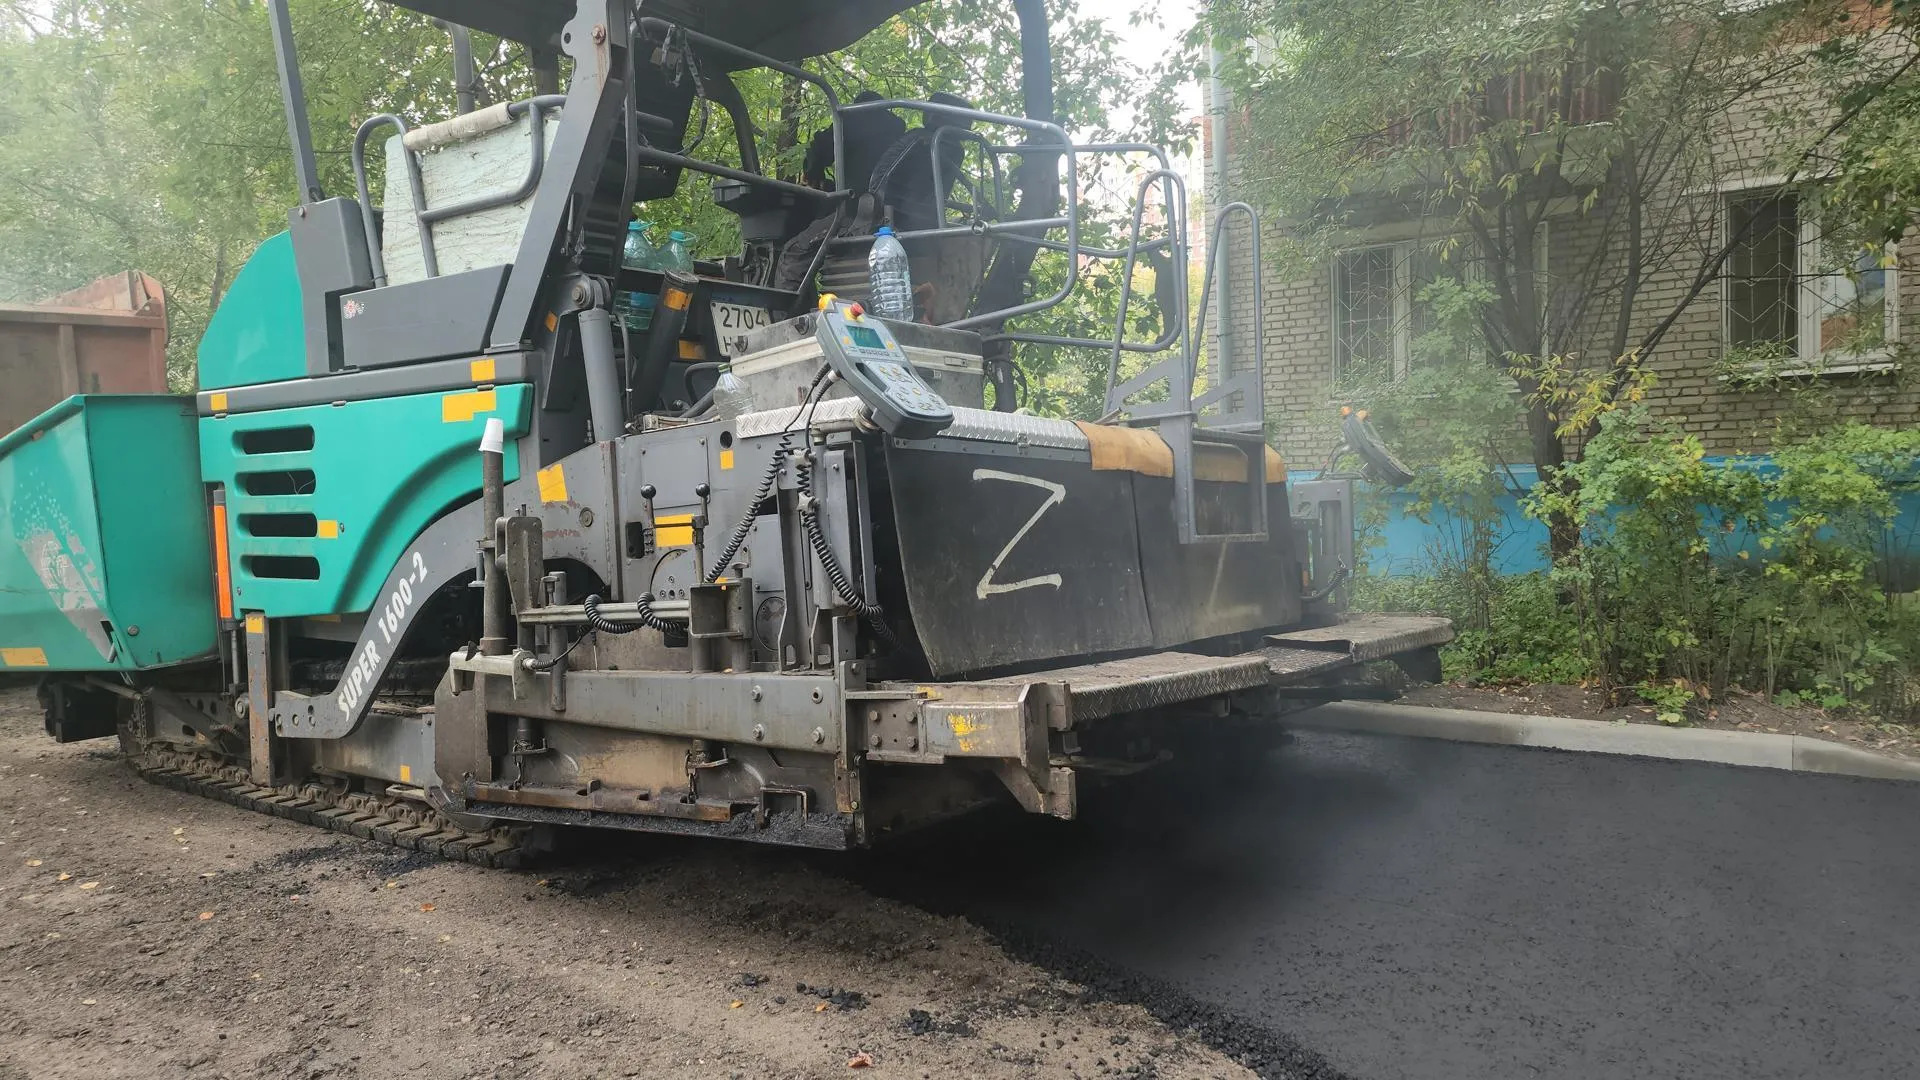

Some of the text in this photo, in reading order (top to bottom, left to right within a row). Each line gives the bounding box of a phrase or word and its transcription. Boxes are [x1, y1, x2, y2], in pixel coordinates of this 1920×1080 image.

[720, 306, 766, 329] 2704
[973, 468, 1066, 600] Z
[338, 551, 428, 722] SUPER 1600-2
